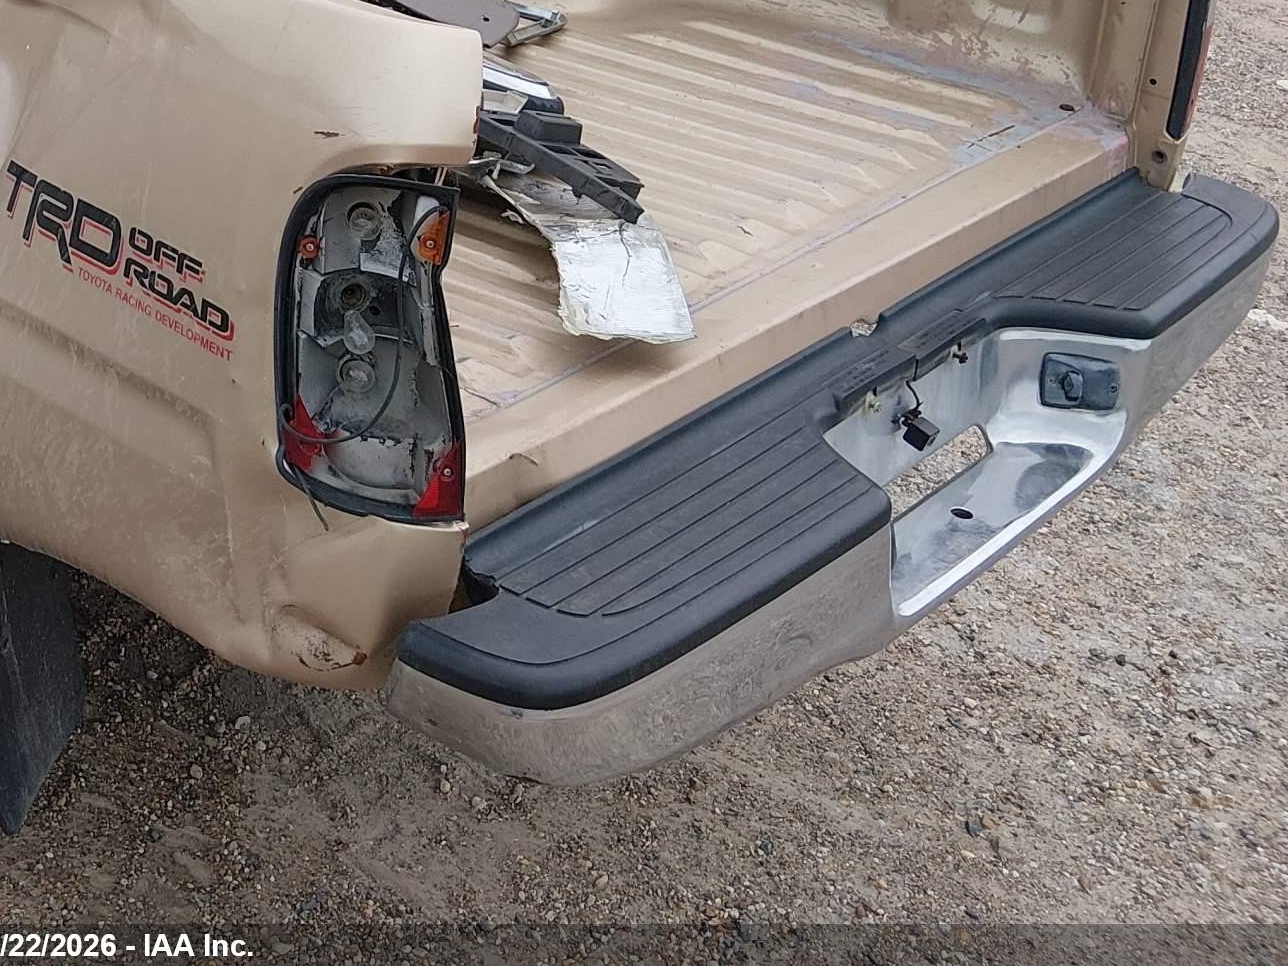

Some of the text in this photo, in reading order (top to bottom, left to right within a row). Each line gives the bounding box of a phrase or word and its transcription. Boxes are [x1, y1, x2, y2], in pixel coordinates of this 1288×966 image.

[6, 160, 124, 274] TRD
[128, 227, 205, 282] OFF
[78, 267, 233, 361] TOYOTA RACING DEVELOPMENT
[123, 257, 234, 341] ROAD
